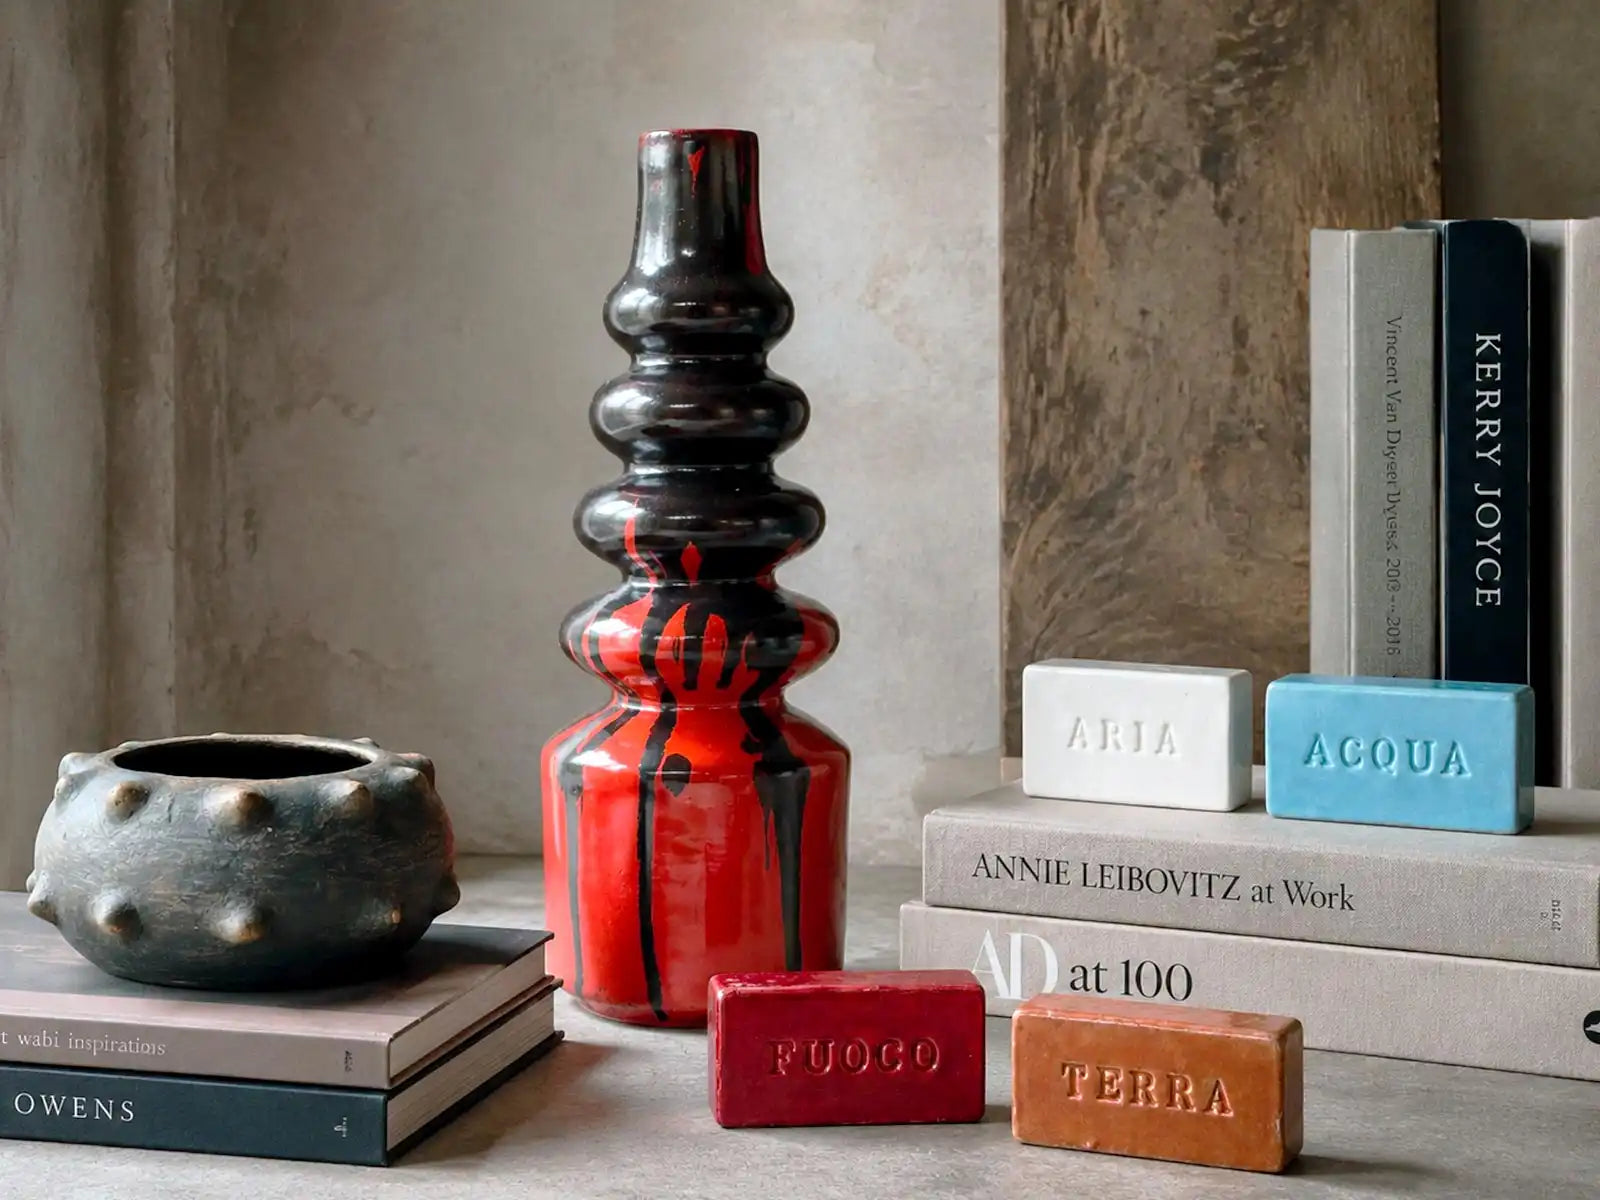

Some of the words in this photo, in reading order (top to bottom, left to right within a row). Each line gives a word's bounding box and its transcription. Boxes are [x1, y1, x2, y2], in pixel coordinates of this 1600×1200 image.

[1386, 316, 1402, 385] Vincent
[1386, 390, 1402, 424] Van
[1476, 333, 1501, 466] KERRY
[1474, 482, 1501, 606] JOYCE
[1067, 716, 1181, 757] ARIA
[1304, 732, 1472, 778] ACQUA
[972, 853, 1071, 887] ANNIE
[1081, 862, 1241, 902] LEIBOVITZ
[1251, 883, 1275, 904] at
[1282, 879, 1356, 911] Work
[971, 929, 1059, 1000] AD
[1069, 963, 1108, 994] at
[1120, 959, 1194, 1001] 100
[17, 1030, 60, 1048] wabi
[768, 1036, 942, 1076] FUOCO
[14, 1092, 135, 1122] OWENS
[1061, 1062, 1235, 1118] TERRA
